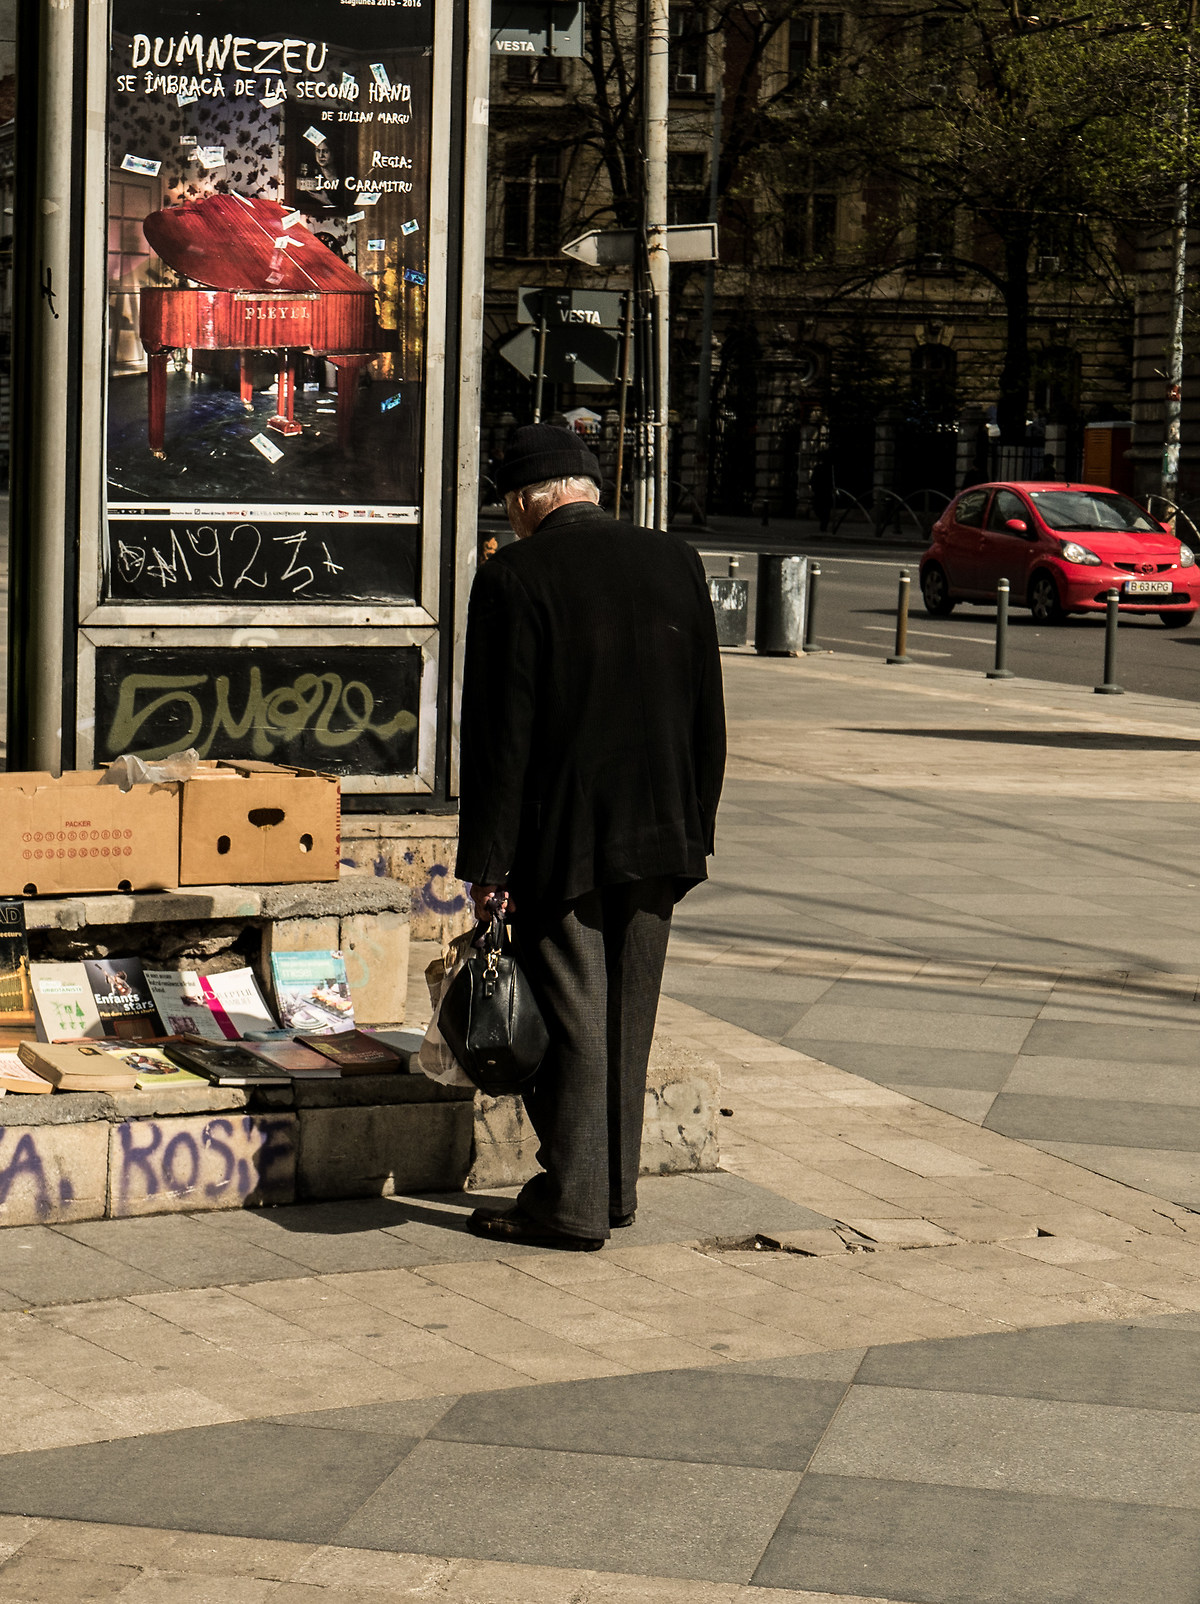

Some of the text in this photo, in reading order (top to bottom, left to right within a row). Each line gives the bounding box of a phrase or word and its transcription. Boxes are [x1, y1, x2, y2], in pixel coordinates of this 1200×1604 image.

[129, 31, 328, 74] DUMNEZEU
[496, 40, 535, 52] VESTA
[117, 75, 135, 93] SE
[235, 78, 257, 97] DE
[264, 76, 288, 99] LA
[297, 80, 360, 101] SECOND
[369, 82, 412, 104] HAND
[321, 110, 410, 124] DE IULIAN MARGU
[345, 177, 413, 194] CARAMITRU
[245, 306, 311, 320] PLEYEL
[560, 309, 601, 325] VESTA
[1131, 582, 1169, 591] B 63 KPG
[64, 820, 92, 828] PACKER
[94, 993, 140, 1005] Enfants
[124, 1000, 154, 1012] stars
